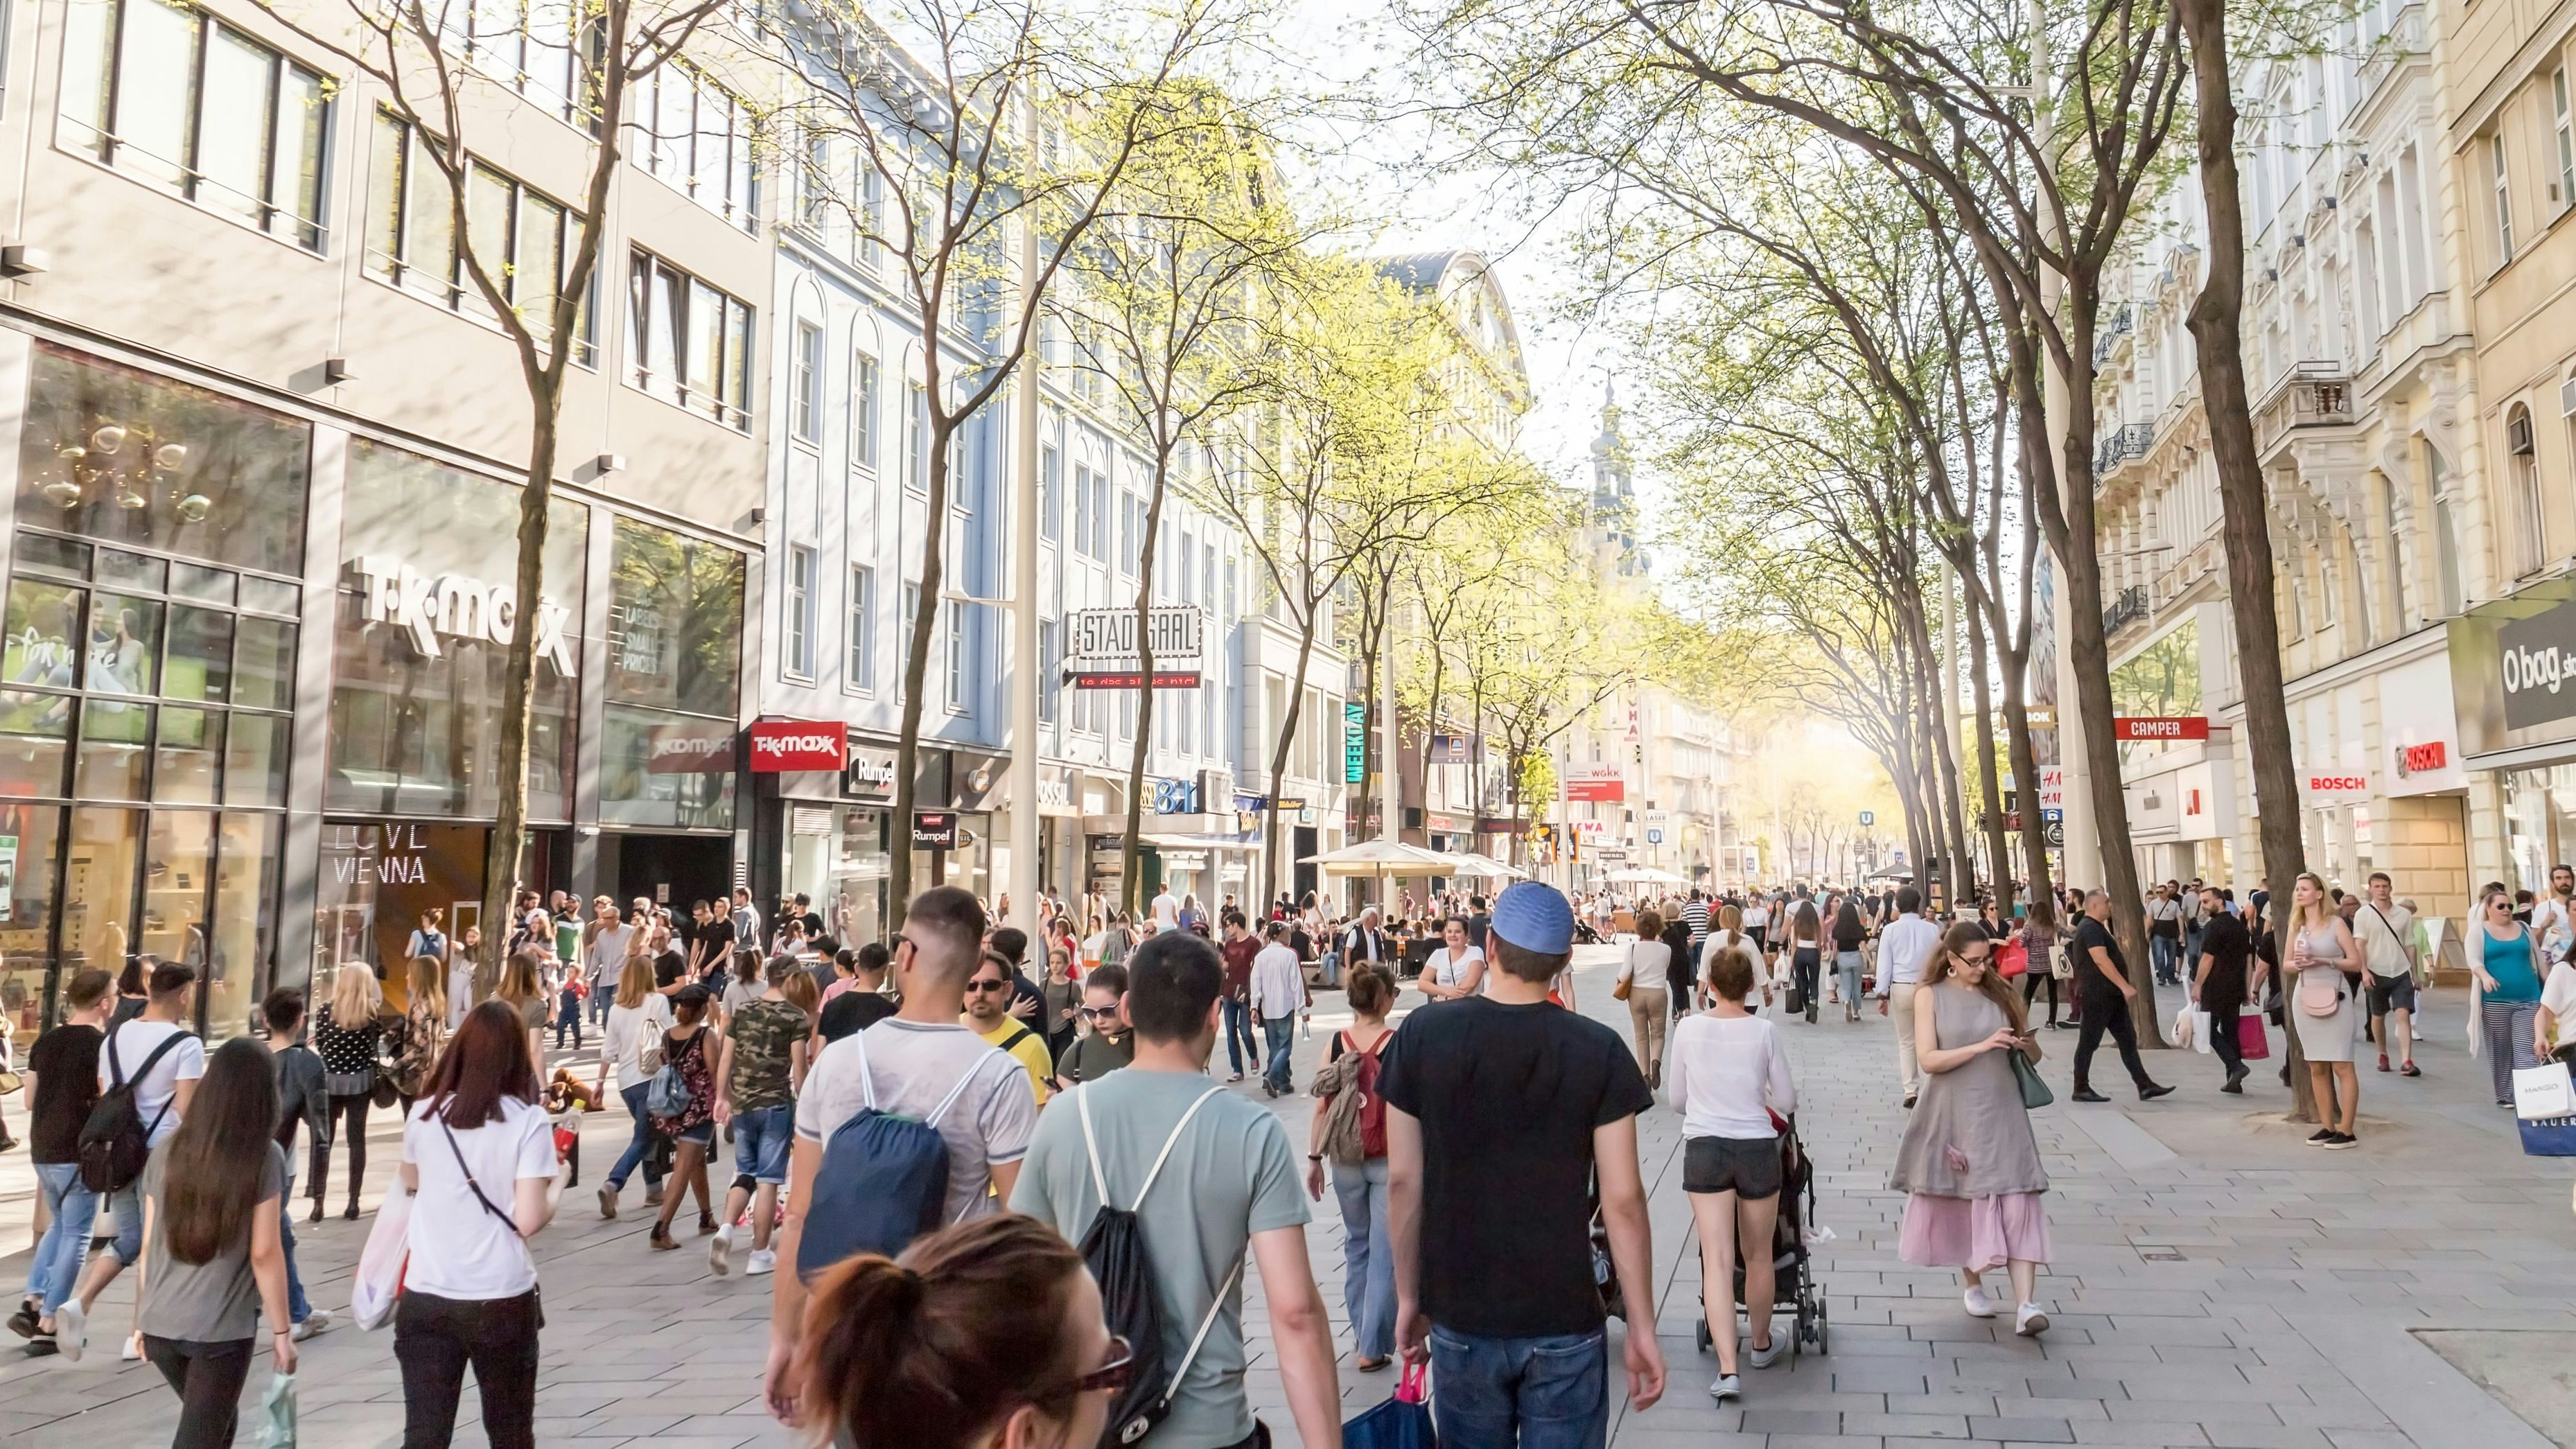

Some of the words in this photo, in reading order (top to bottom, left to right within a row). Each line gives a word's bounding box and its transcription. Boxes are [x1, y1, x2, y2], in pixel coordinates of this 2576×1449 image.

[2131, 722, 2180, 735] CAMPER
[2406, 742, 2441, 771] BOSCH
[858, 757, 895, 786] Rumpel
[2311, 778, 2366, 789] BOSCH
[2041, 793, 2061, 804] H&M
[912, 829, 950, 843] Rumpel
[2525, 1083, 2559, 1094] MANGO
